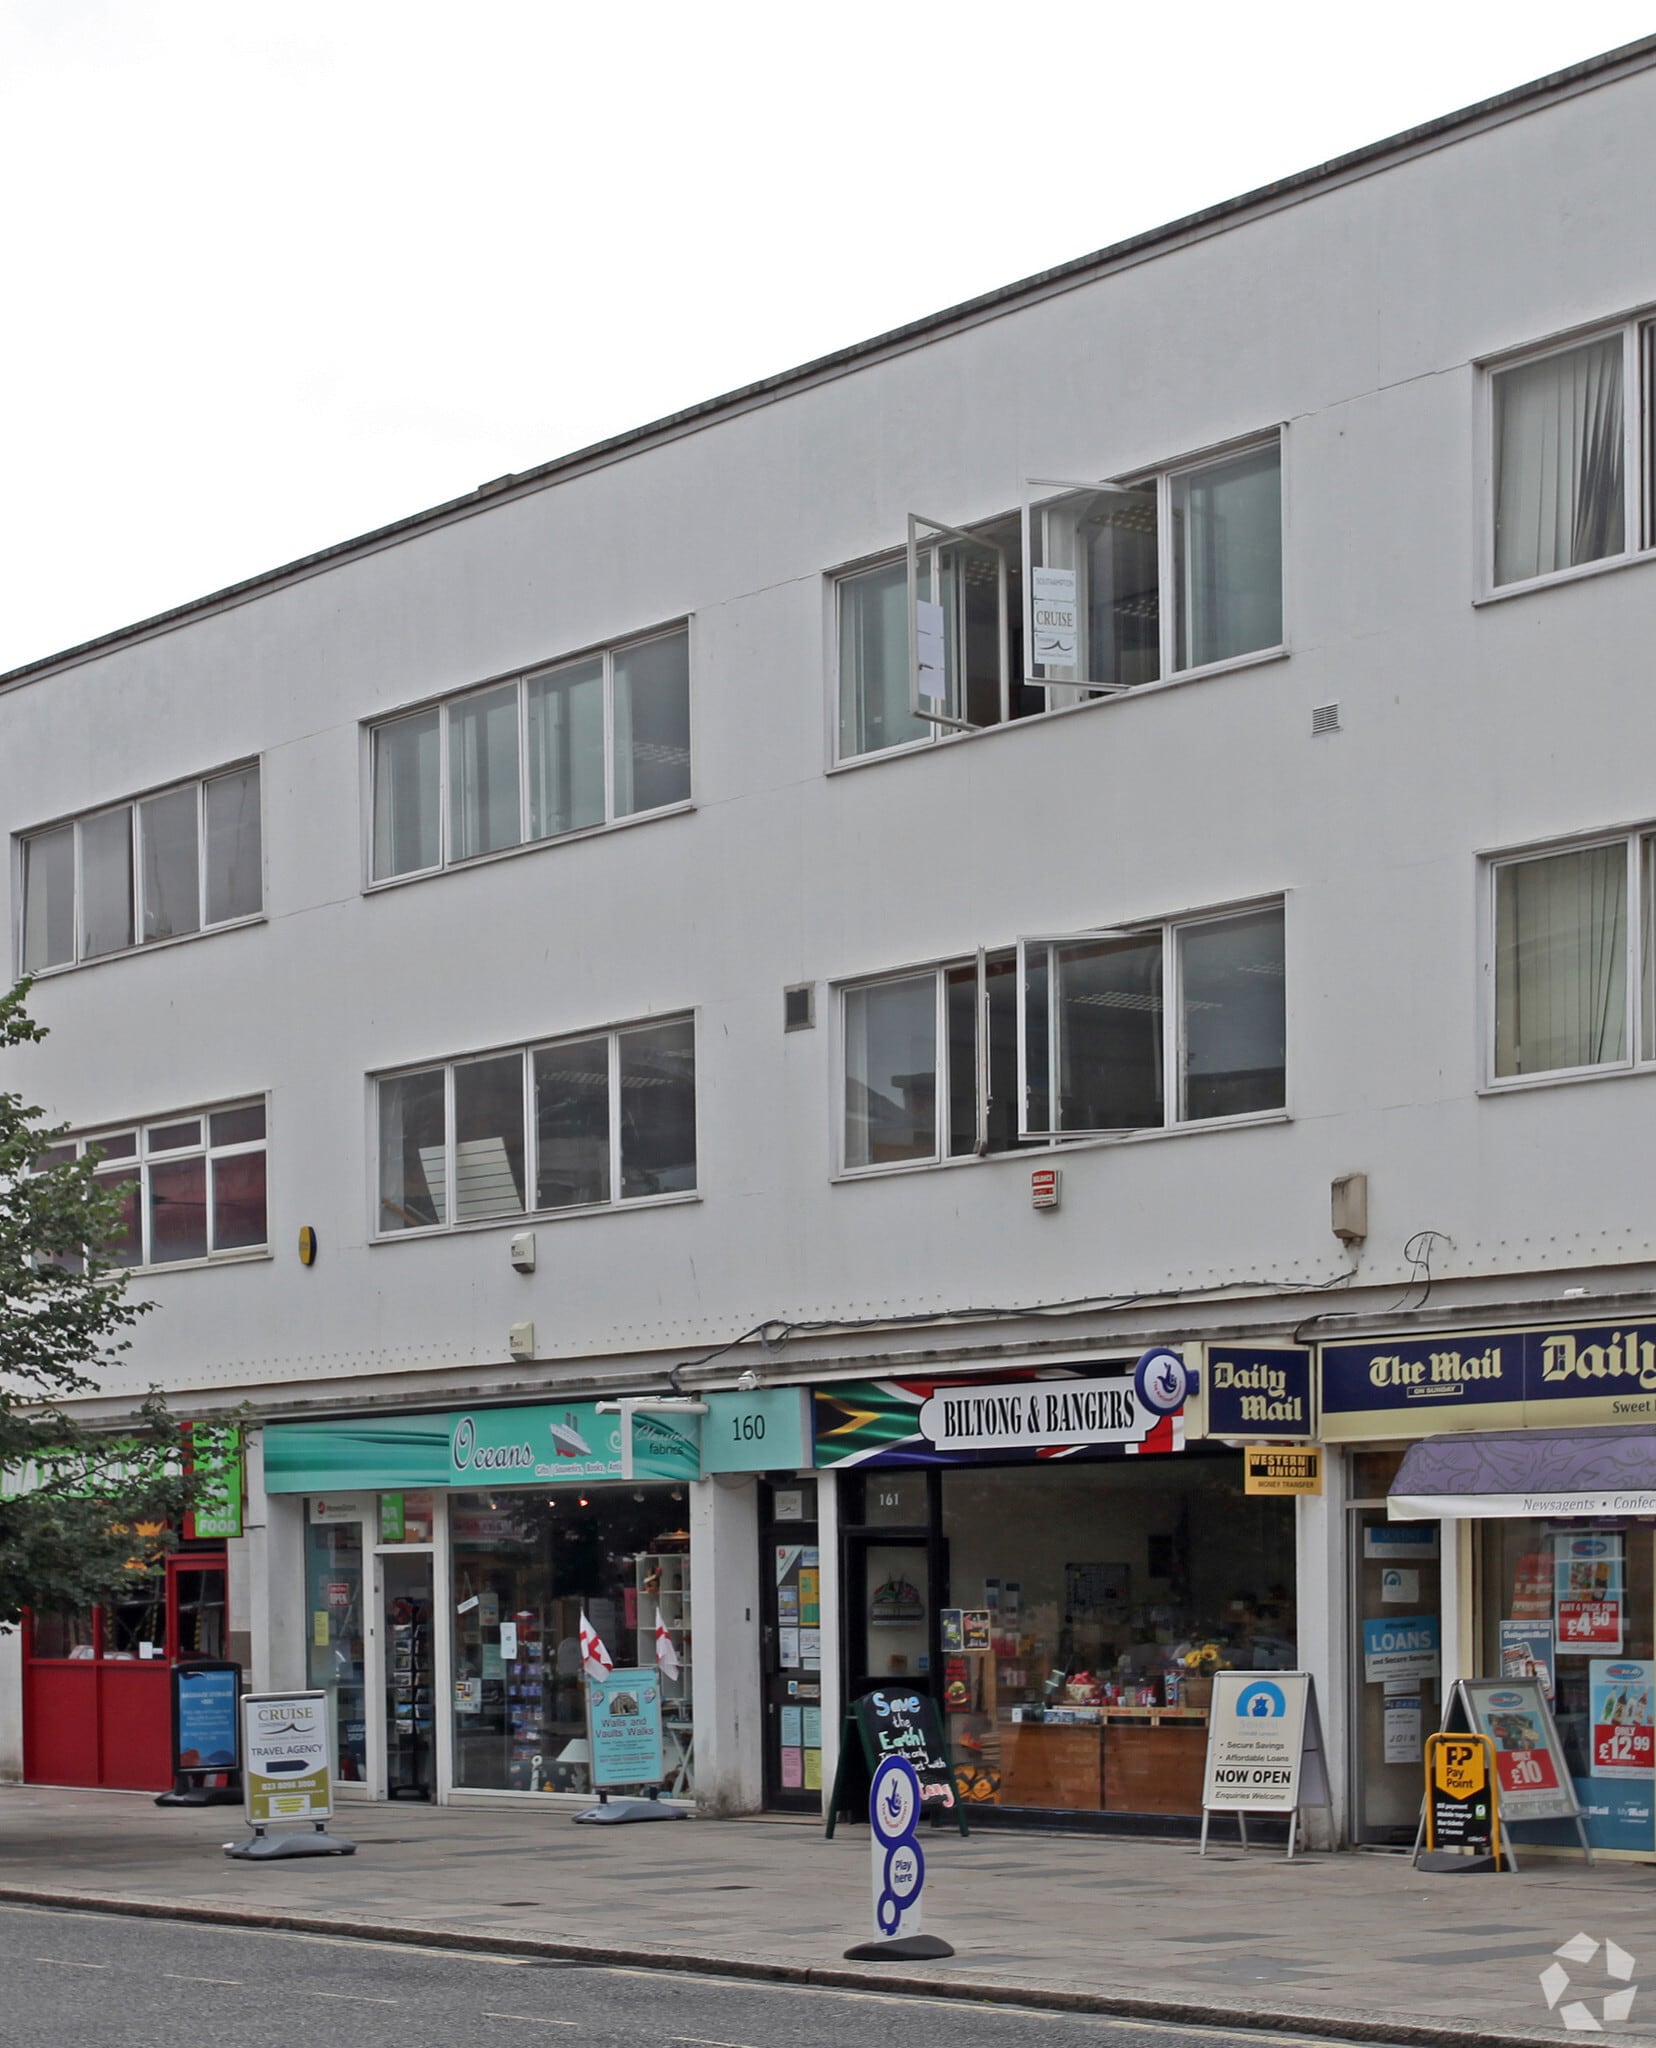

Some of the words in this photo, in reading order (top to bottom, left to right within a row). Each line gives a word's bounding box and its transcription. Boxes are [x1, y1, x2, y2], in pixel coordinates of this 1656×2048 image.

[1036, 610, 1073, 627] CRUISE
[1368, 1354, 1427, 1387] The
[1429, 1348, 1503, 1382] Mail
[1213, 1362, 1286, 1398] Daily
[1427, 1386, 1456, 1395] SUNDAY
[943, 1396, 1022, 1437] BILTONG
[1027, 1395, 1041, 1433] &
[1046, 1389, 1135, 1432] BANGERS
[1240, 1395, 1303, 1421] Mail
[1612, 1401, 1651, 1414] Sweet
[732, 1415, 765, 1441] 160
[453, 1416, 535, 1471] Oceans
[1250, 1454, 1306, 1466] WESTERN
[1267, 1466, 1306, 1476] UNION
[1282, 1480, 1314, 1488] TRANSFER
[879, 1493, 899, 1506] 161
[1522, 1498, 1595, 1512] Newsagents
[1613, 1496, 1656, 1510] Confec
[199, 1503, 235, 1517] ST
[199, 1519, 237, 1533] FOOD
[1582, 1603, 1600, 1611] PACK
[1371, 1630, 1432, 1652] LOANS
[1385, 1655, 1407, 1664] Secure
[872, 1692, 920, 1716] Save
[258, 1707, 313, 1721] CRUISE
[892, 1713, 911, 1728] the
[601, 1719, 626, 1728] Walls
[630, 1718, 647, 1726] and
[595, 1729, 624, 1738] Vaults
[627, 1728, 654, 1736] Walks
[1615, 1726, 1635, 1737] ONLY
[878, 1727, 926, 1750] Earth!
[251, 1746, 285, 1757] TRAVEL
[287, 1744, 323, 1755] AGENCY
[1227, 1741, 1253, 1749] Secure
[1255, 1742, 1284, 1751] Savings
[928, 1757, 947, 1768] with
[1226, 1754, 1264, 1762] Affordable
[1512, 1751, 1532, 1761] ONLY
[1215, 1770, 1249, 1783] NOW
[1253, 1770, 1292, 1784] OPEN
[1446, 1767, 1464, 1779] Pay
[1511, 1760, 1543, 1784] £10
[1446, 1778, 1474, 1789] Point
[919, 1782, 954, 1808] tong
[1215, 1791, 1250, 1800] Enquiries
[1252, 1792, 1286, 1800] Welcome
[895, 1859, 912, 1873] Play
[894, 1872, 912, 1884] here
